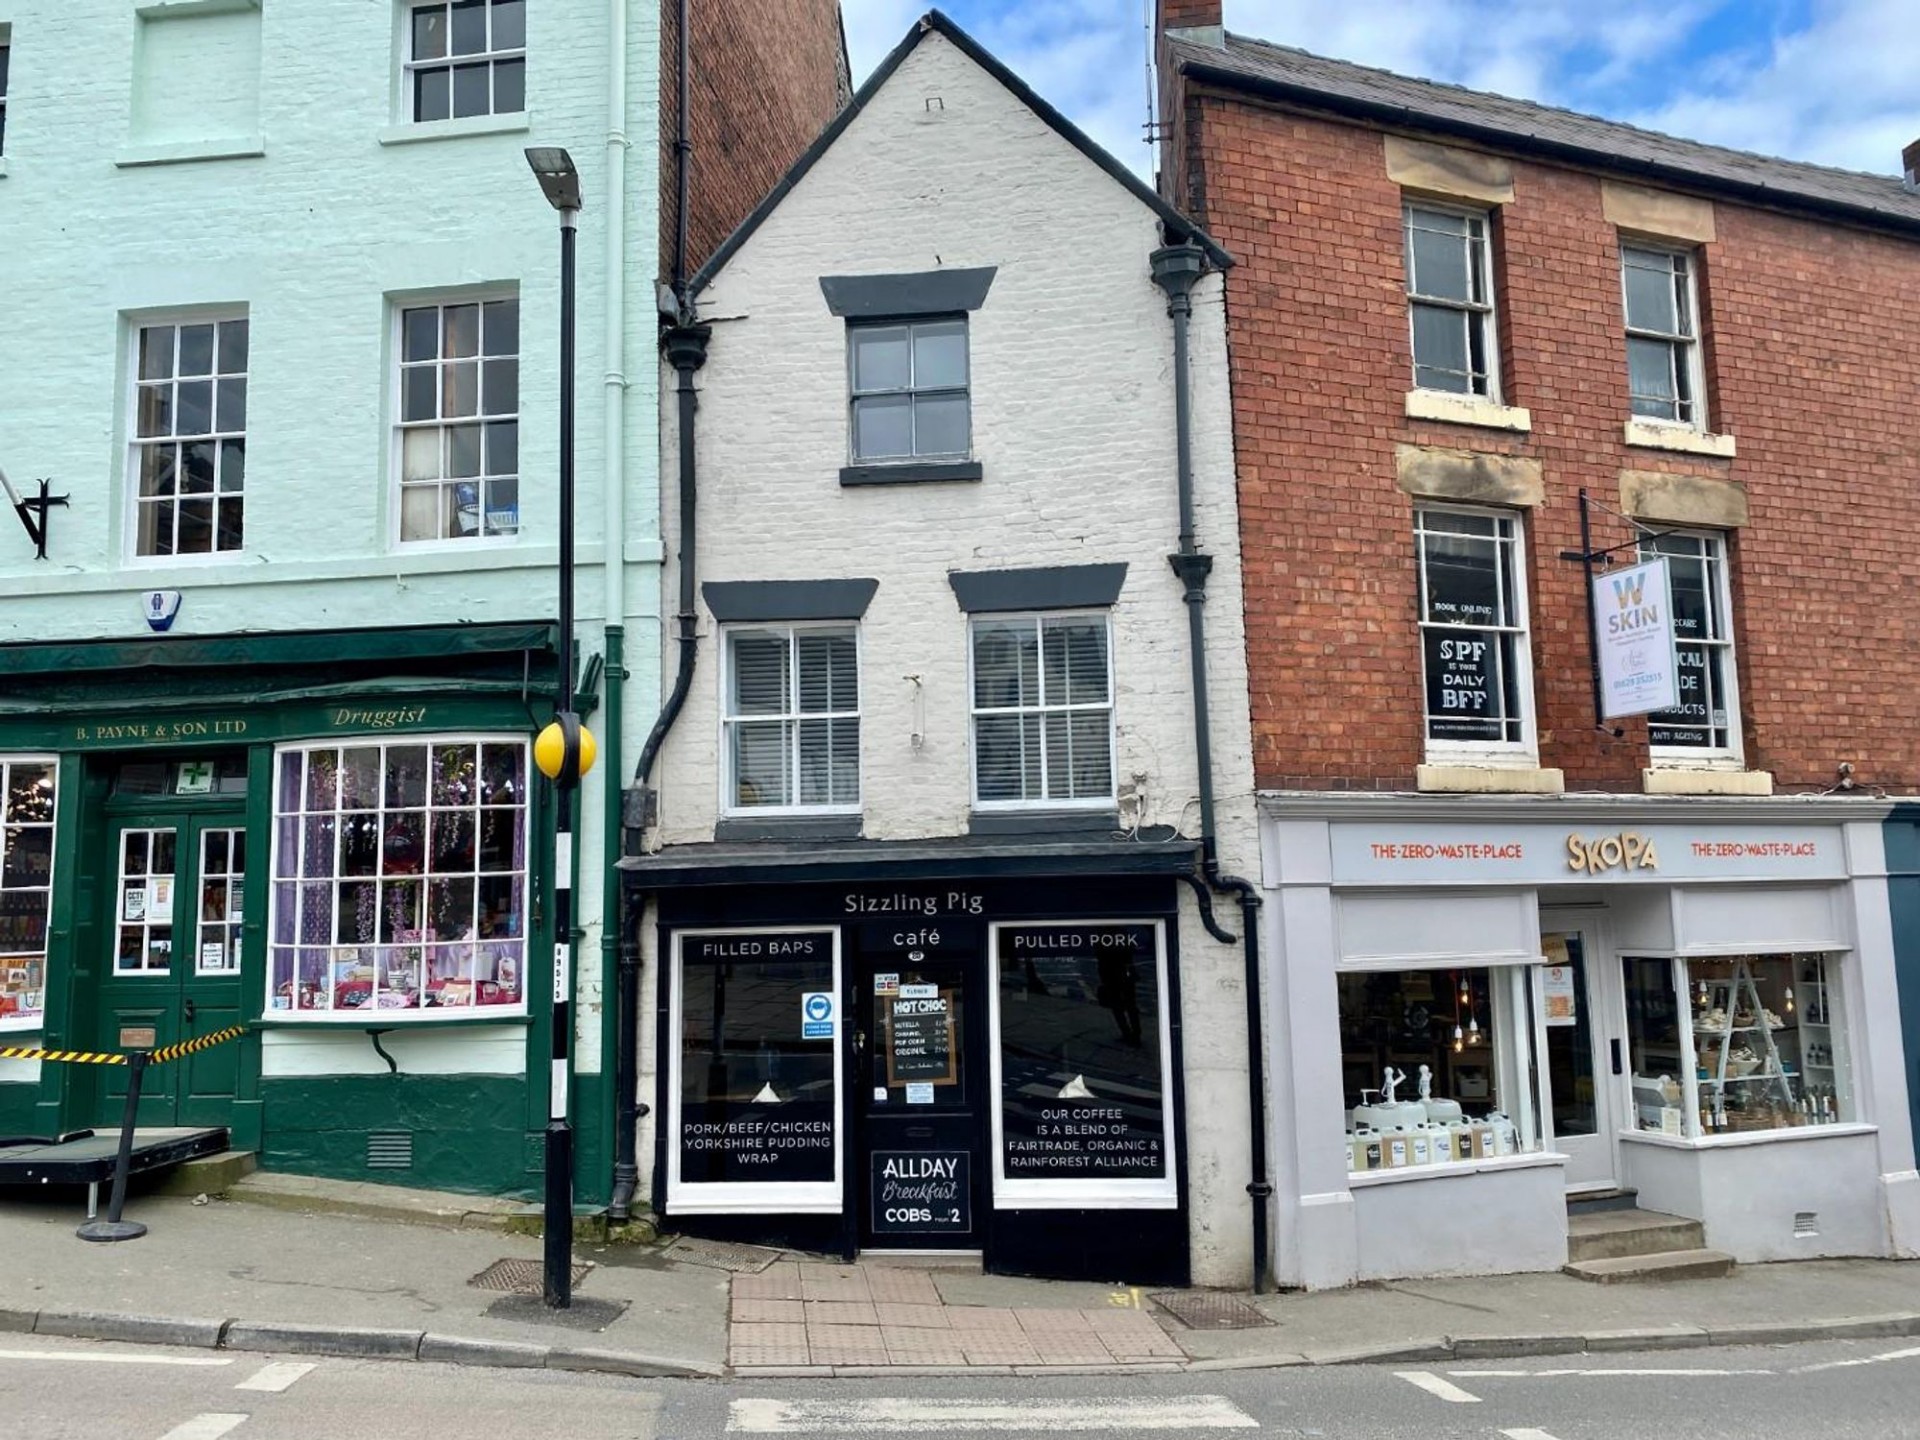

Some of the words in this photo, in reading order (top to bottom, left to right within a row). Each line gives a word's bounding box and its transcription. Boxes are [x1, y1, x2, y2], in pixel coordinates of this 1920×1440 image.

[1613, 572, 1646, 609] W
[1461, 604, 1493, 615] ONLINE
[1608, 605, 1658, 634] SKIN
[1440, 640, 1487, 661] SPF
[1443, 674, 1486, 687] DAILY
[1442, 689, 1488, 709] BFF
[334, 706, 426, 728] Druggist
[77, 727, 90, 740] B.
[97, 725, 149, 739] PAYNE
[155, 725, 166, 737] &
[173, 722, 208, 736] SON
[215, 720, 247, 733] LTD
[1566, 831, 1659, 875] SKOPA
[845, 893, 938, 915] Sizzling
[947, 892, 983, 915] Pig
[893, 928, 940, 946] café
[1015, 934, 1083, 948] PULLED
[1090, 934, 1139, 947] PORK
[703, 942, 762, 956] FILLED
[769, 941, 814, 954] BAPS
[893, 1000, 917, 1014] HOT
[918, 999, 947, 1012] CHOC
[1041, 1109, 1068, 1119] OUR
[1072, 1109, 1123, 1119] COFFEE
[1037, 1125, 1048, 1135] IS
[1052, 1125, 1061, 1135] A
[1065, 1124, 1107, 1135] BLEND
[1111, 1124, 1128, 1135] OF
[685, 1138, 764, 1150] YORKSHIRE
[768, 1137, 831, 1148] PUDDING
[1009, 1141, 1084, 1152] FAIRTRADE,
[1087, 1140, 1147, 1151] ORGANIC
[1150, 1140, 1159, 1150] &
[737, 1153, 779, 1164] WRAP
[1010, 1156, 1090, 1167] RAINFOREST
[1095, 1156, 1158, 1167] ALLIANCE
[882, 1180, 959, 1204] Breakfast
[885, 1208, 932, 1222] COBS
